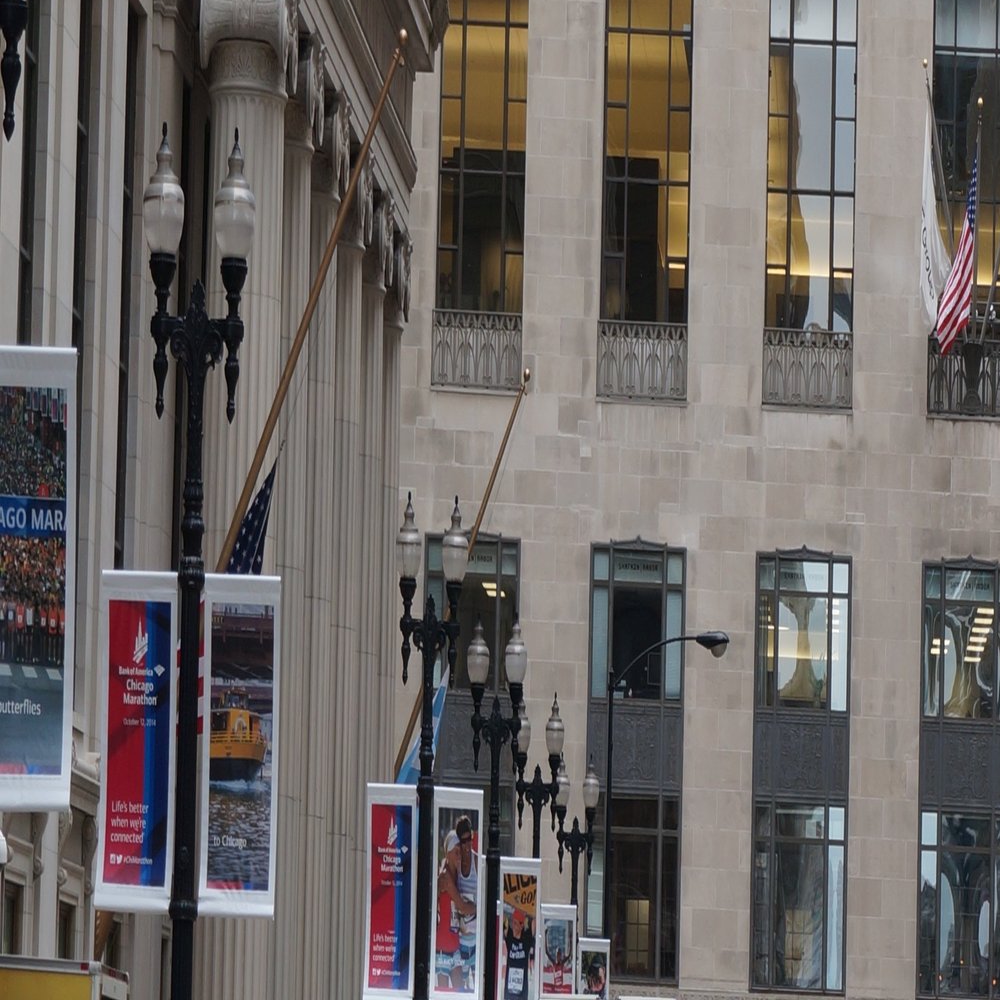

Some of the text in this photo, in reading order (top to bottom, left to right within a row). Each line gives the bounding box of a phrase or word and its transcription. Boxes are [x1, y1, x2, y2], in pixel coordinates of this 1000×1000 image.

[126, 679, 154, 694] Chicago
[123, 692, 157, 706] Marathon
[111, 801, 149, 814] Life's better
[111, 816, 128, 827] when
[110, 832, 143, 844] connected
[213, 835, 247, 849] to Chicago
